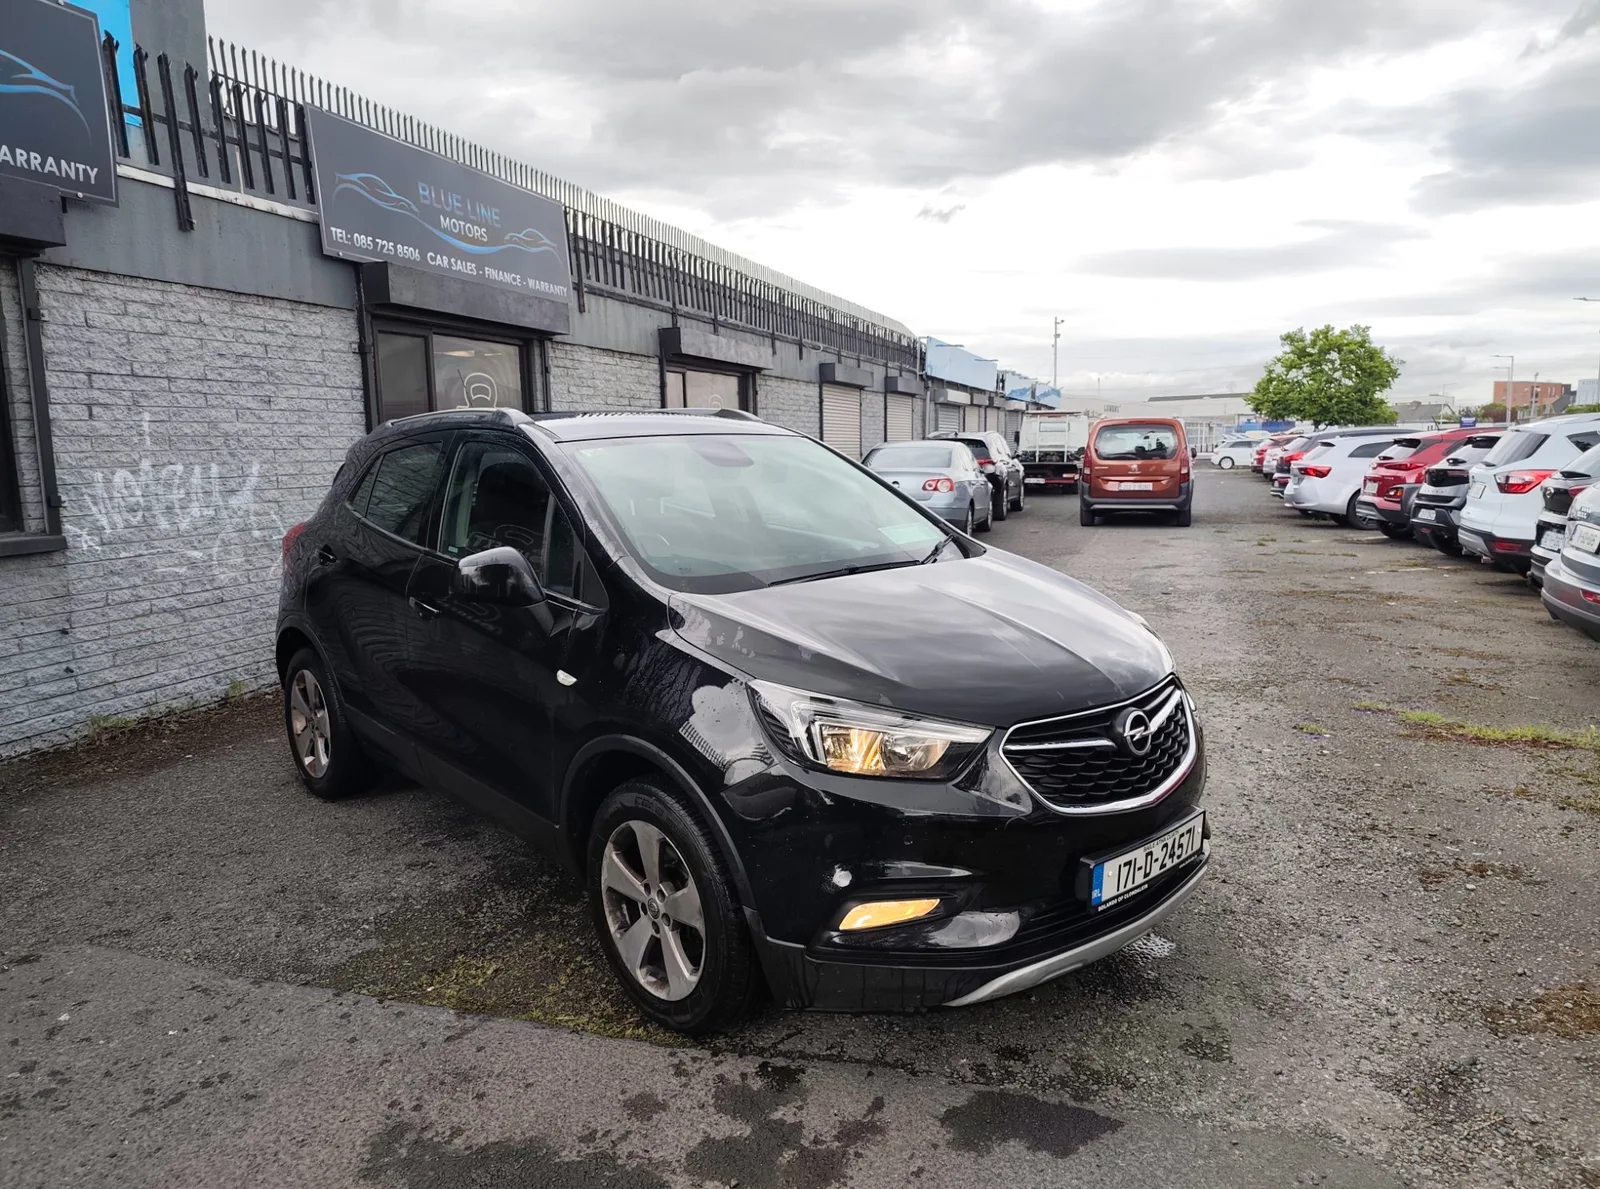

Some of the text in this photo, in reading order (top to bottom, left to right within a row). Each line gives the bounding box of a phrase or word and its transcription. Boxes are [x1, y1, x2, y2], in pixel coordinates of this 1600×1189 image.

[418, 181, 501, 228] BLUE LINE
[440, 214, 488, 242] MOTORS
[330, 226, 352, 245] TEL:
[353, 233, 374, 250] 085
[375, 238, 395, 255] 725
[397, 244, 421, 262] 8506
[427, 252, 449, 268] CAR
[450, 258, 477, 276] SALES
[485, 266, 522, 287] FINANCE
[527, 278, 568, 297] WARRANTY
[1116, 825, 1196, 892] 171-D-24571
